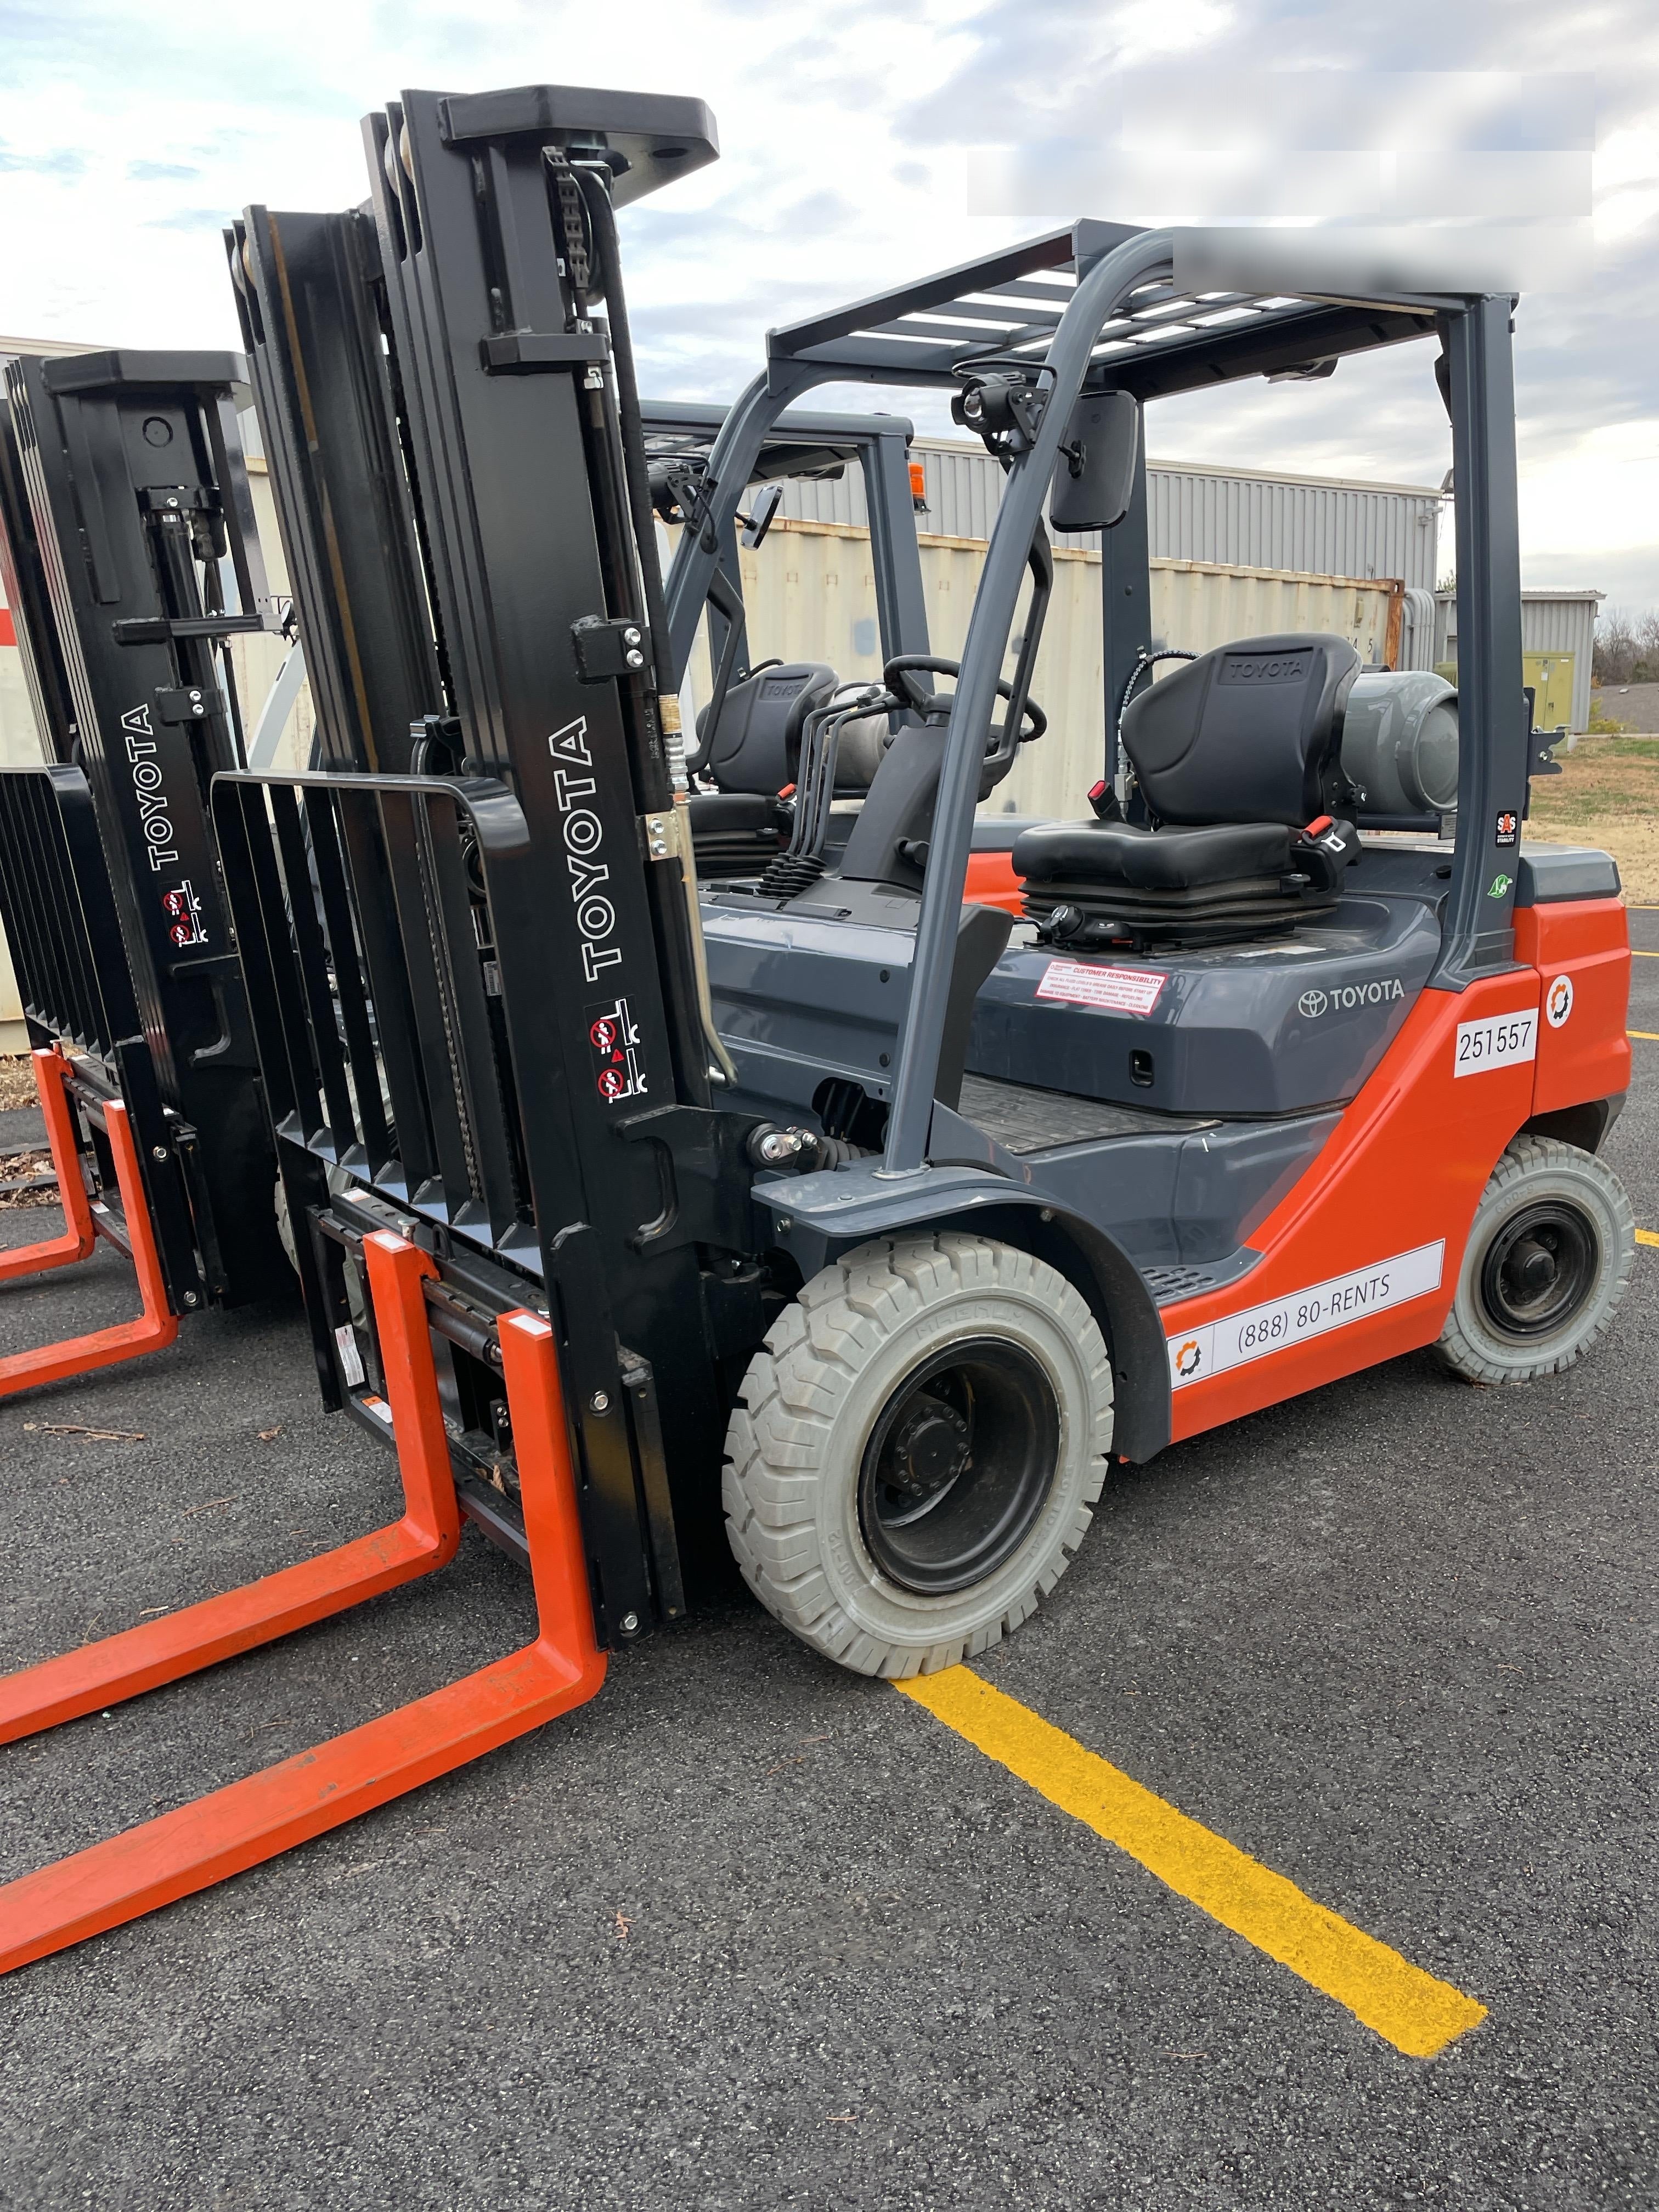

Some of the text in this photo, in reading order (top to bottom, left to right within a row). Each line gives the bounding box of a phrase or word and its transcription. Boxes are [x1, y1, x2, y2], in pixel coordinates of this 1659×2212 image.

[1231, 661, 1302, 678] TOYOTA
[121, 703, 179, 871] TOYOTA
[1497, 814, 1516, 833] SAS
[549, 715, 622, 983] TOYOTA
[1073, 967, 1107, 977] CUSTOMER
[1107, 973, 1162, 985] RESPONSIBILITY
[1330, 979, 1405, 1010] TOYOTA
[1459, 1021, 1532, 1061] 251557
[1238, 1274, 1390, 1353] (888) 80-RENTS
